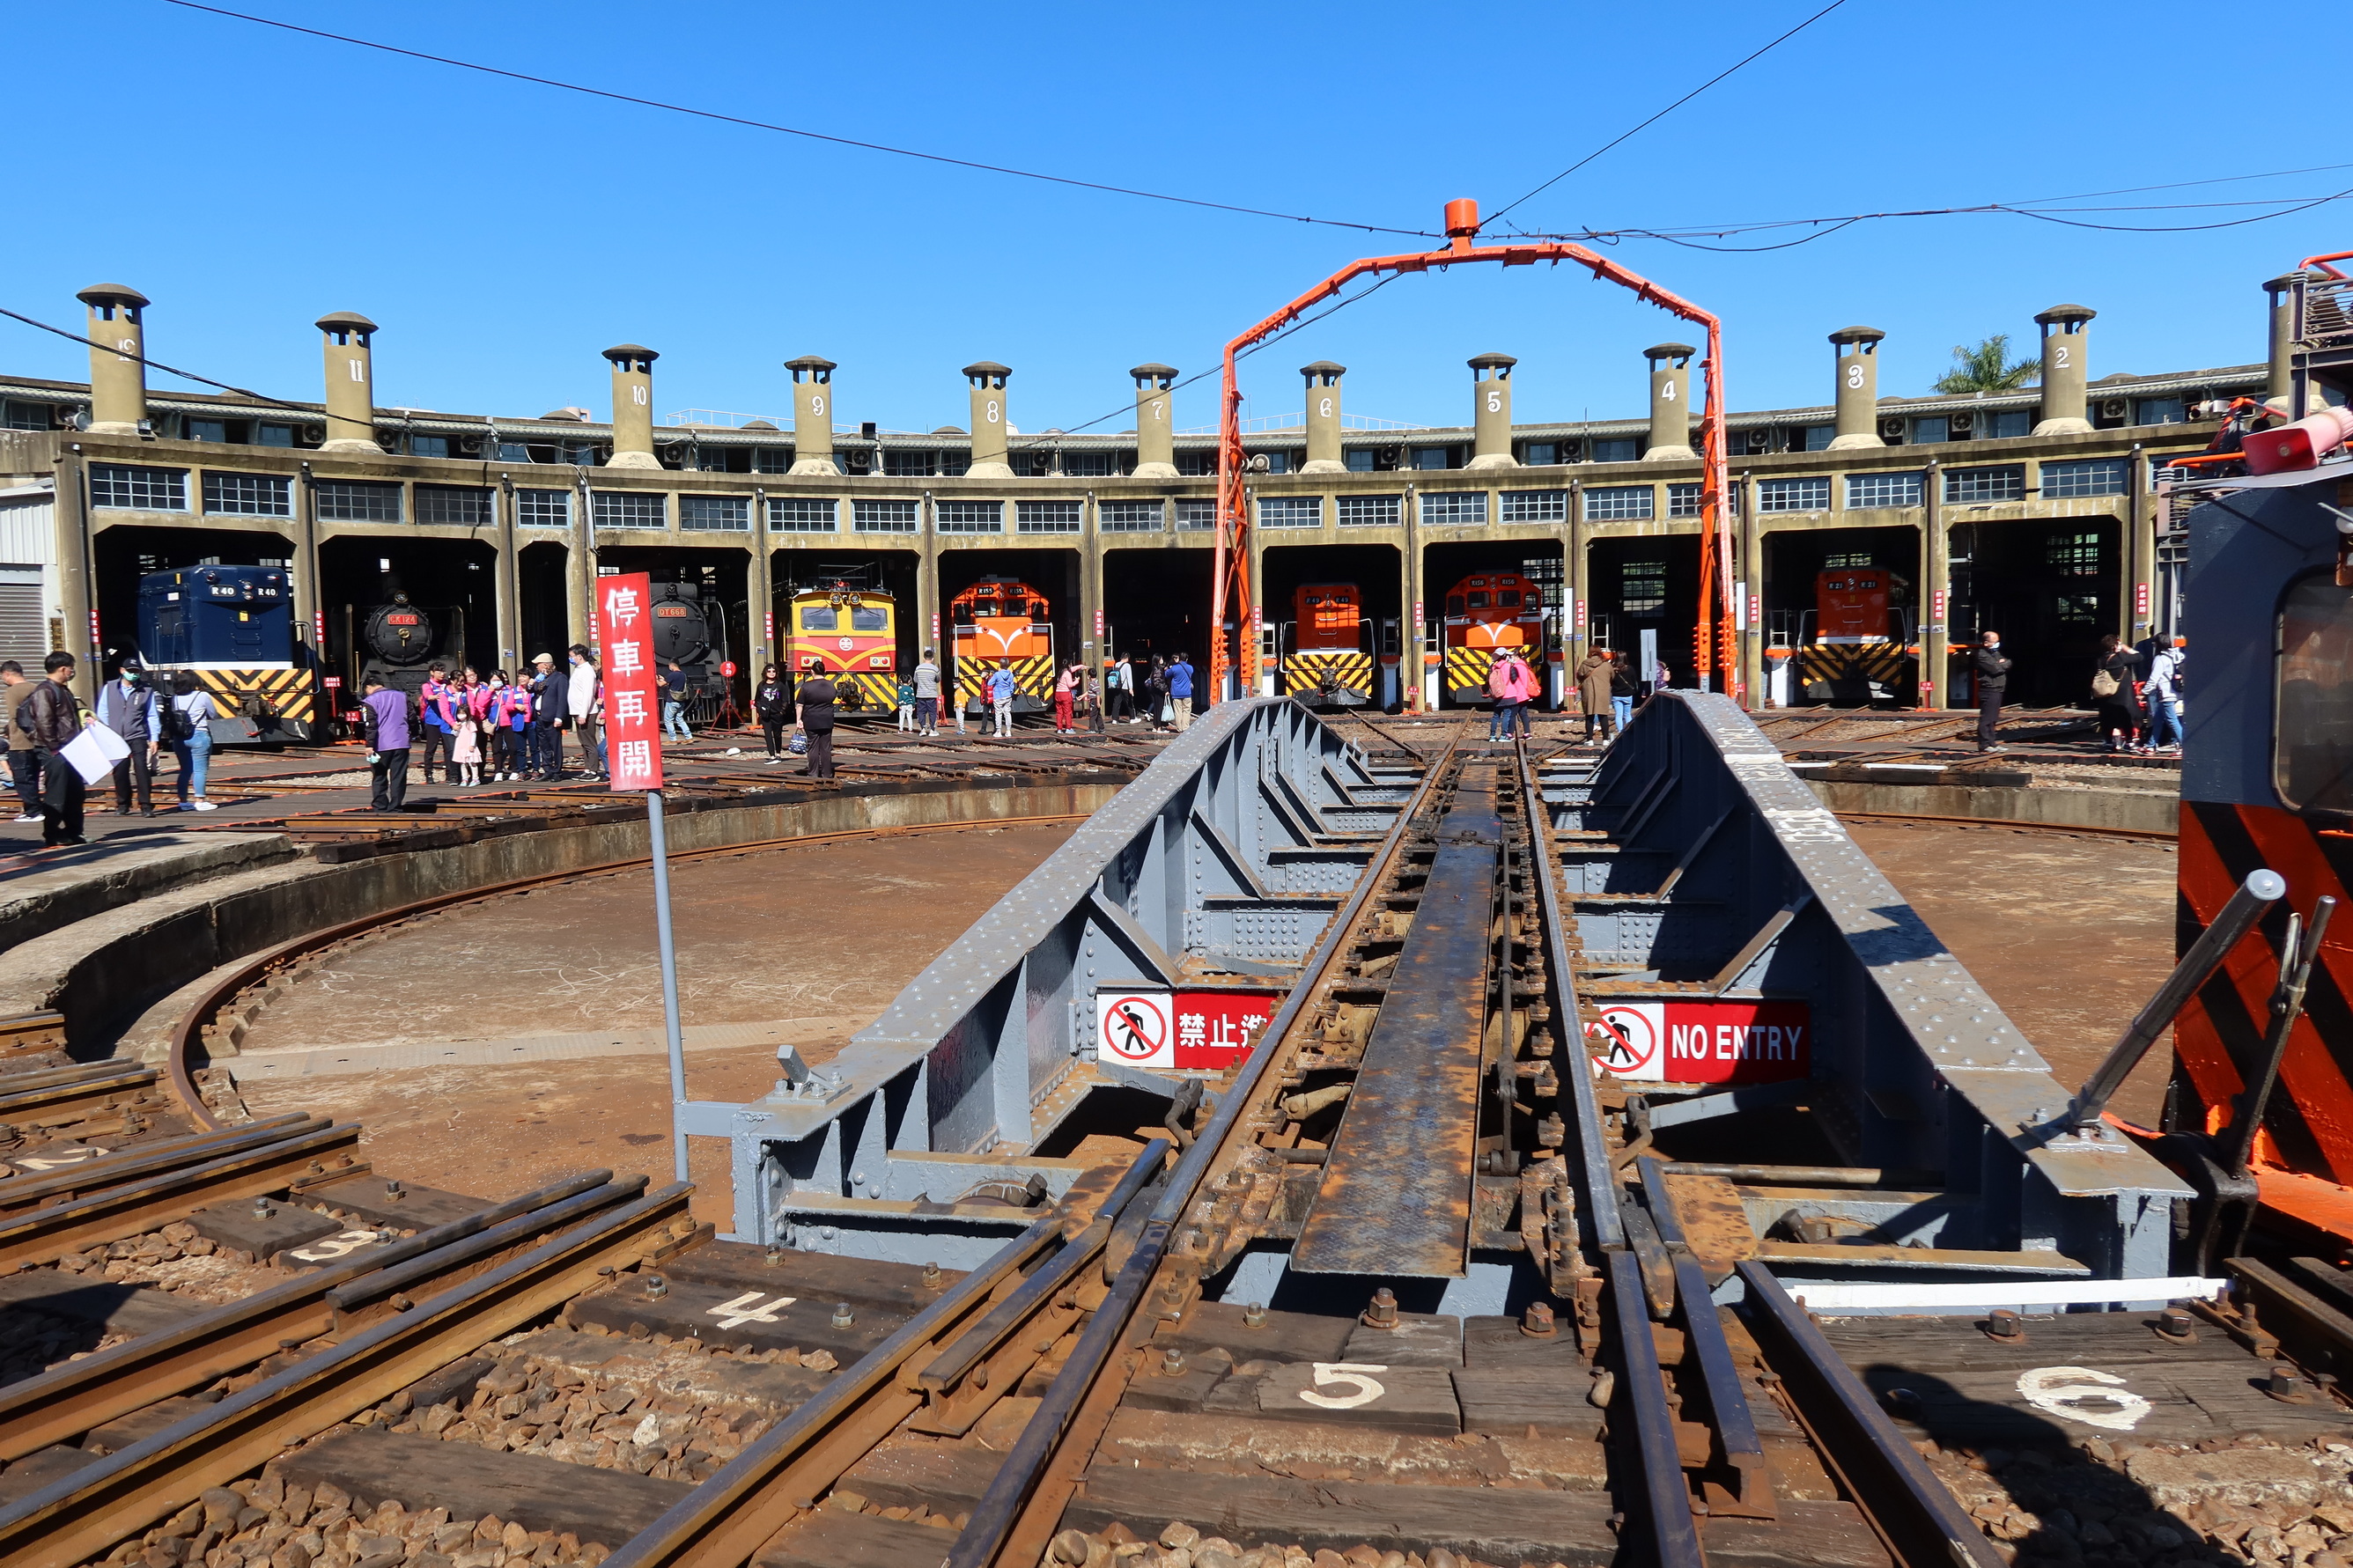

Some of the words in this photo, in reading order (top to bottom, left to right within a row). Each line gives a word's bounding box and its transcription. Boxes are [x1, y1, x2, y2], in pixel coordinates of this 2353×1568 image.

[2054, 346, 2069, 369] 2
[349, 359, 364, 382] 11
[1848, 364, 1863, 389] 3
[632, 385, 646, 406] 10
[1663, 379, 1677, 401] 4
[812, 395, 824, 416] 9
[986, 401, 999, 423] 8
[1152, 401, 1162, 420] 7
[1319, 397, 1332, 418] 6
[1487, 391, 1501, 413] 5
[605, 587, 652, 778] 停車再開
[1671, 1024, 1708, 1060] NO
[1715, 1025, 1803, 1061] ENTRY
[290, 1230, 378, 1262] 3
[705, 1291, 797, 1330] 4
[1299, 1362, 1388, 1410] 5
[2015, 1366, 2152, 1431] 6
